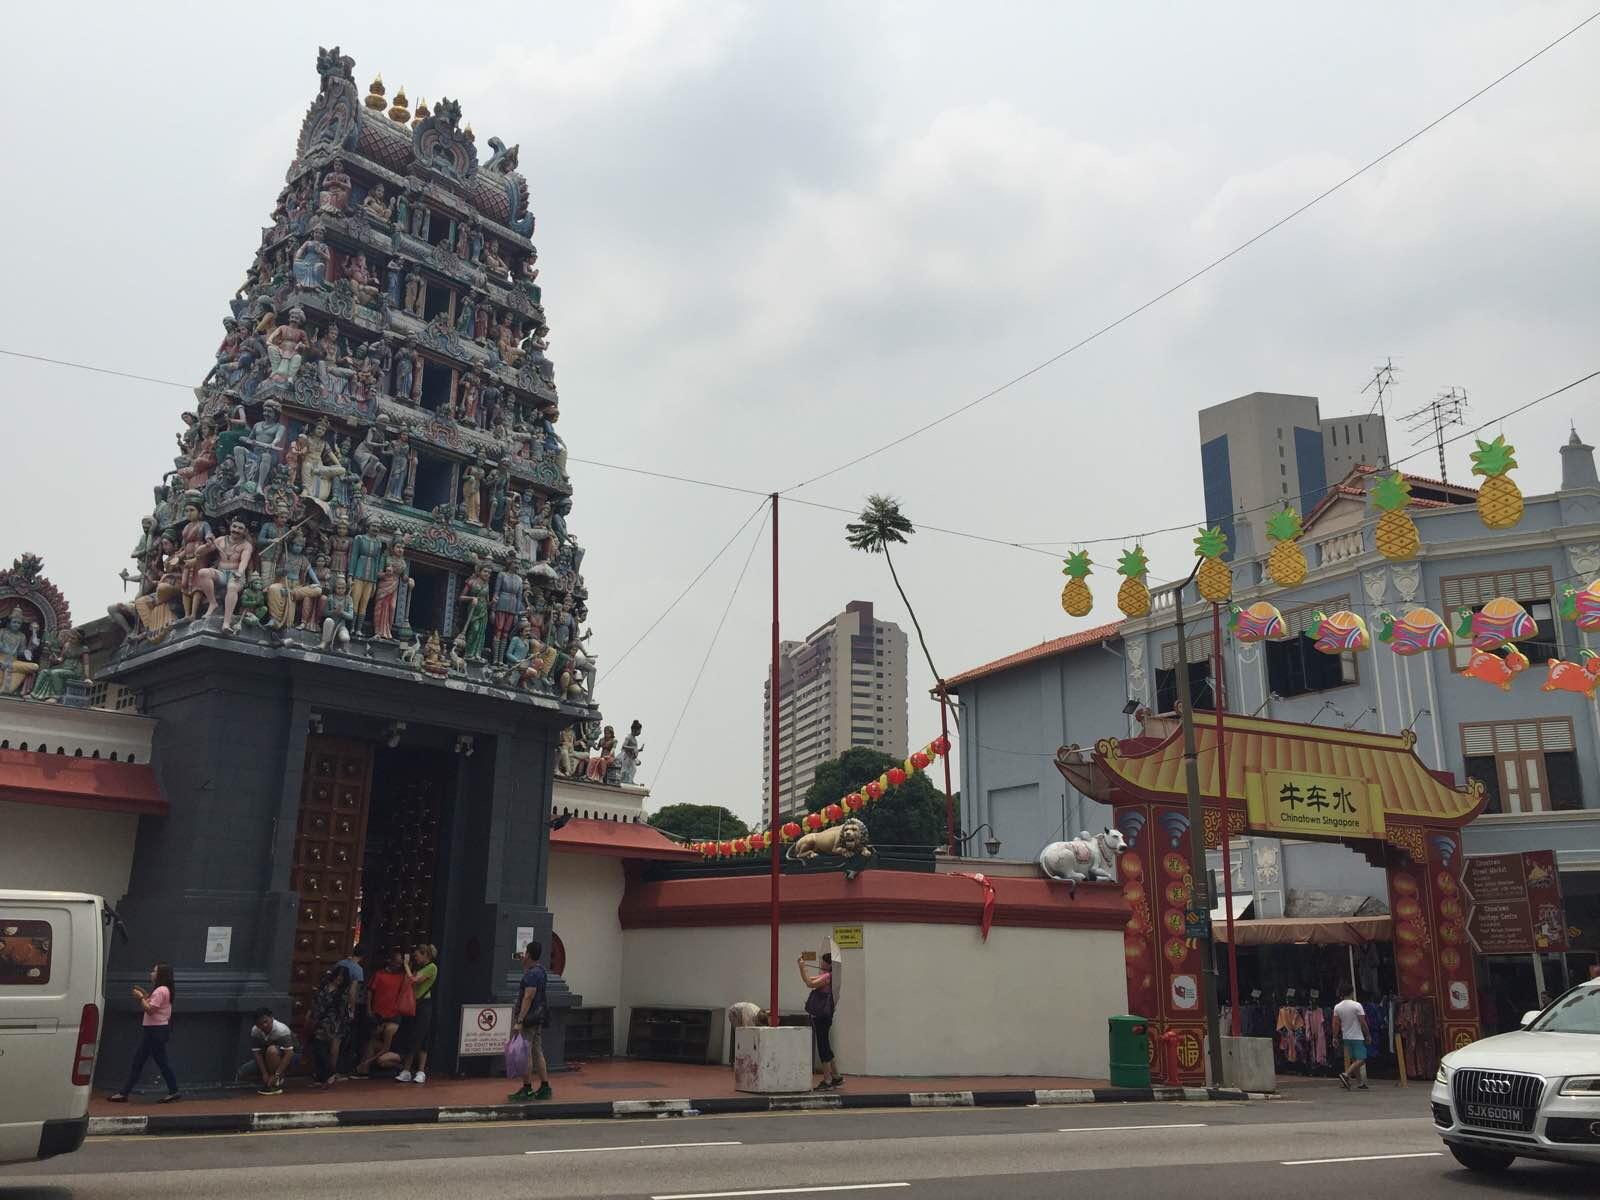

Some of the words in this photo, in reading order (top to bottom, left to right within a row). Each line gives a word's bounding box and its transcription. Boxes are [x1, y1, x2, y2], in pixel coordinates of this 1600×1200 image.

[1279, 781, 1357, 813] 牛车水
[1280, 812, 1321, 825] Chinatown
[1322, 816, 1360, 828] Singapore
[1176, 1034, 1200, 1067] 福
[1467, 1104, 1520, 1121] SJX6001M
